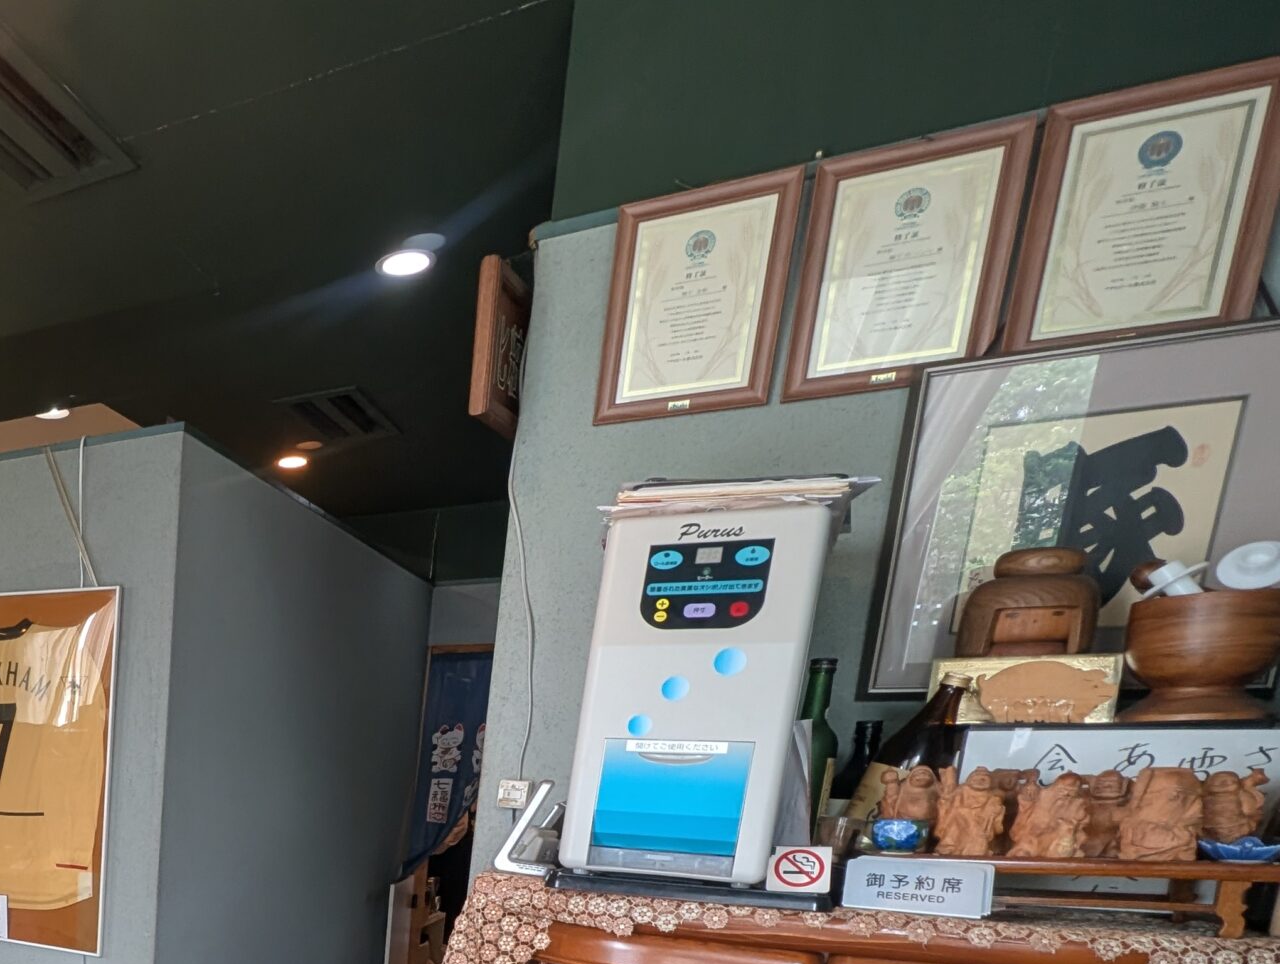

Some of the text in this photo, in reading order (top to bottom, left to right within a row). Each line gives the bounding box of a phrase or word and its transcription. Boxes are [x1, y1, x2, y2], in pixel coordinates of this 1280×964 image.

[678, 522, 745, 541] Purus
[865, 872, 963, 894] 御予約席
[876, 890, 945, 904] RESERVED
